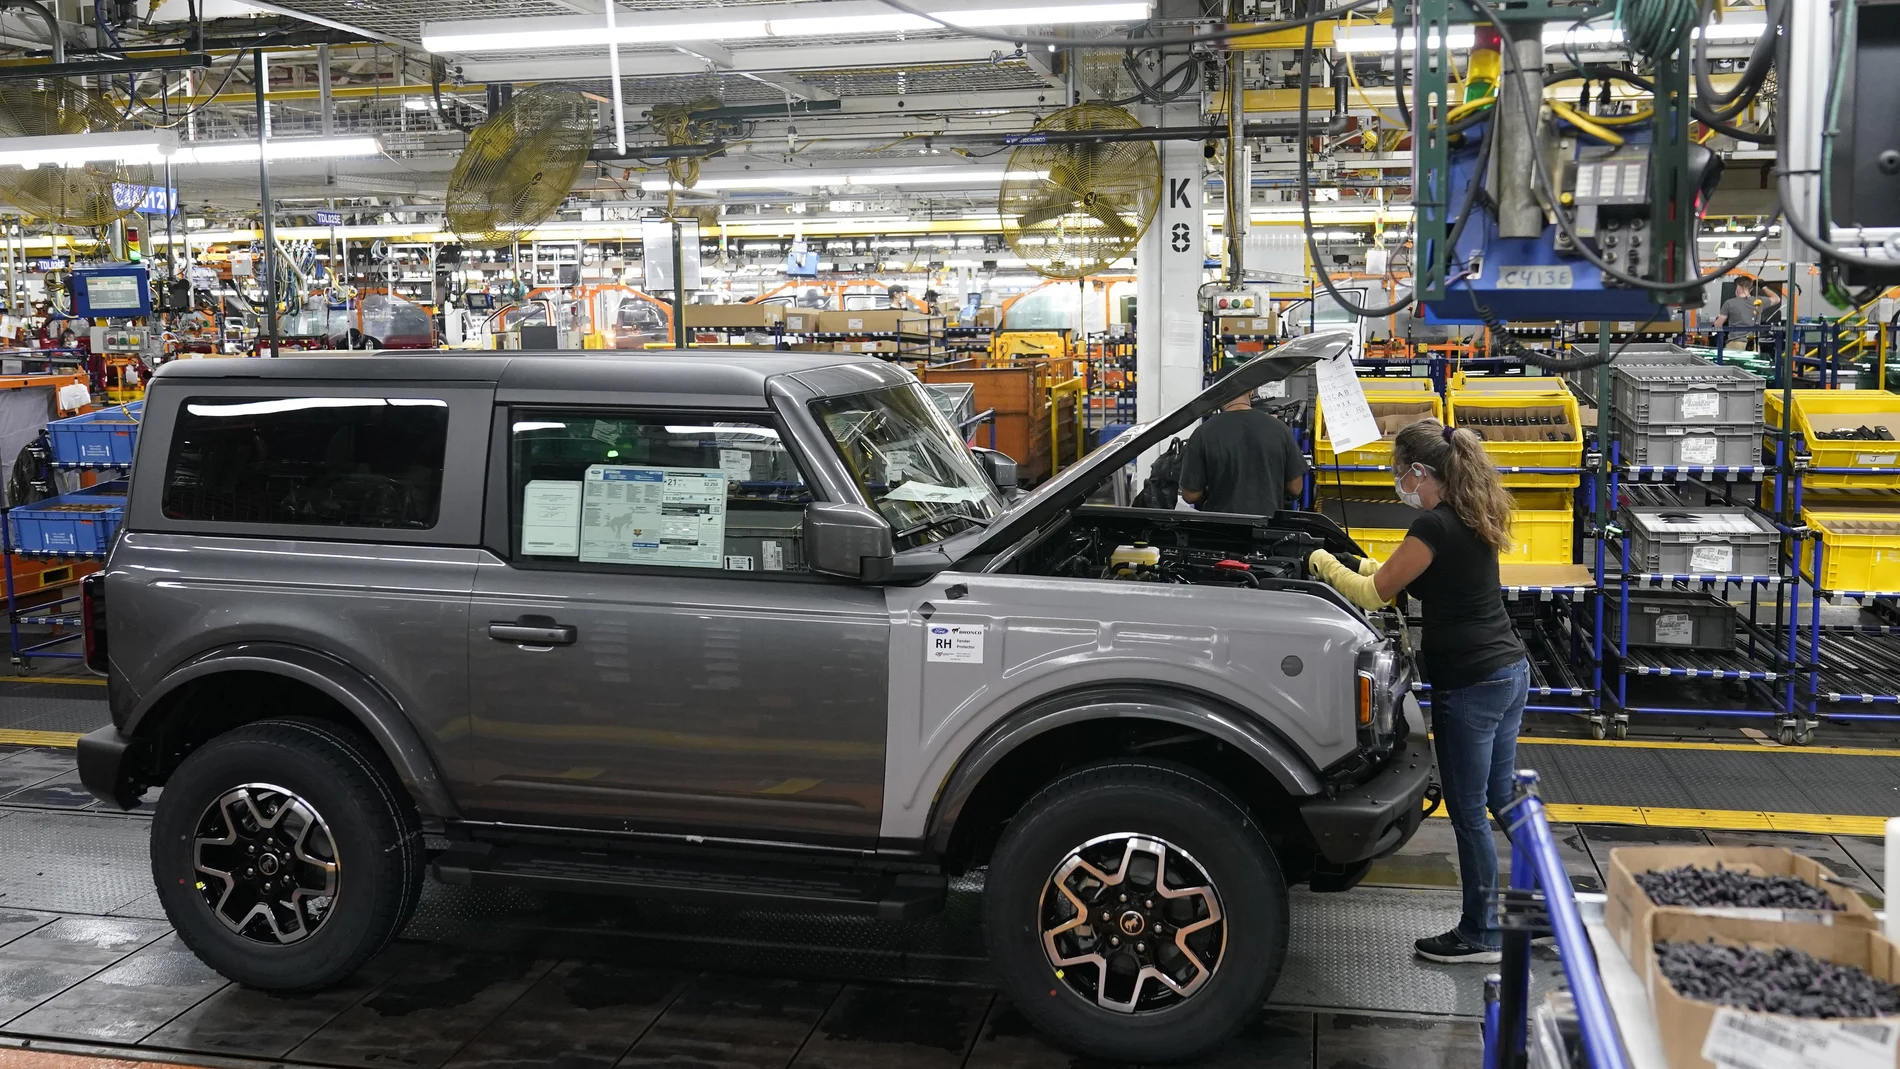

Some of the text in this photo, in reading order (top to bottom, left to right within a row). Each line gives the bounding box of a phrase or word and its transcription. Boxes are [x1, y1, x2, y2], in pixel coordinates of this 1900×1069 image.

[1170, 178, 1192, 208] K
[1171, 222, 1191, 253] 8
[1505, 271, 1568, 286] C413E
[936, 639, 951, 649] RH
